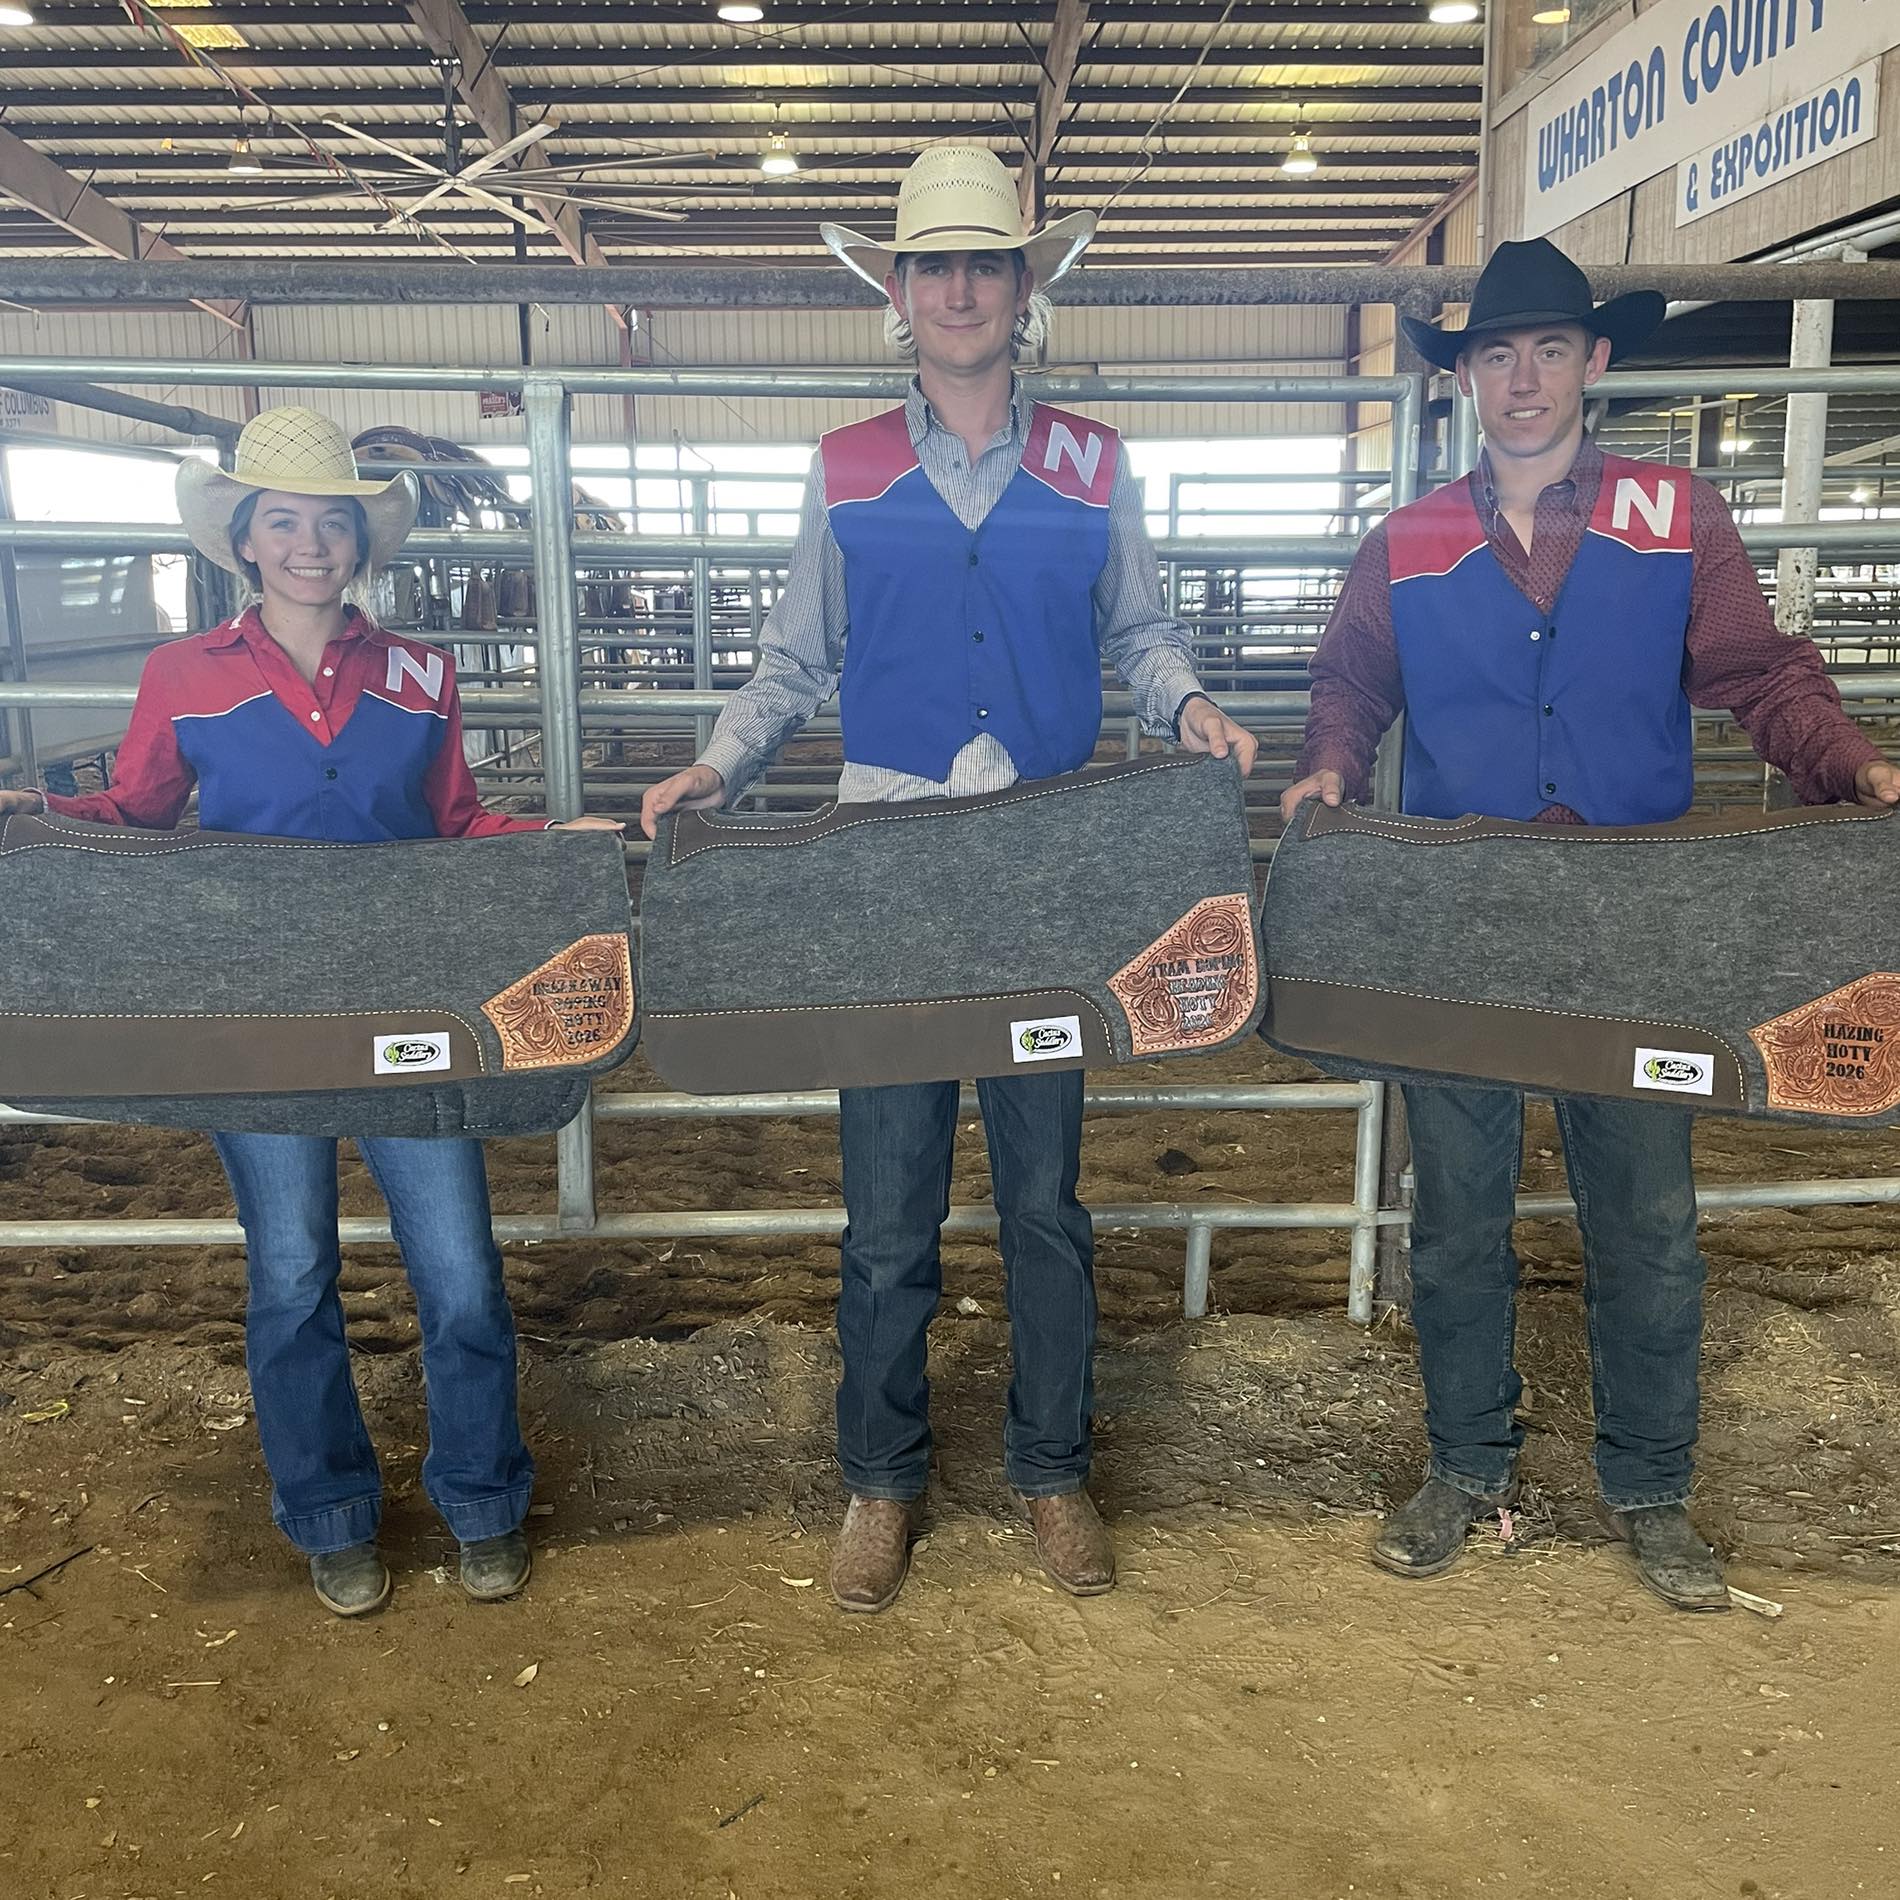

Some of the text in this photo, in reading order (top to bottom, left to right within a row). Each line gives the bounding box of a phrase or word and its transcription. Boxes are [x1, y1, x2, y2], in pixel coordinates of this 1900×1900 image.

[1538, 45, 1666, 193] WHARTON
[1686, 77, 1861, 213] & EXPOSITION
[4, 391, 49, 415] COLUMBUS
[1043, 421, 1102, 488] N
[1612, 478, 1675, 539] N
[386, 646, 443, 701] N
[567, 1028, 601, 1044] 2026
[1038, 1028, 1060, 1039] Cactus
[1823, 1023, 1884, 1042] HAZING
[403, 1043, 429, 1052] Cactus
[1826, 1043, 1872, 1061] HOTY
[1665, 1060, 1691, 1071] Cactus
[1826, 1062, 1865, 1080] 2026
